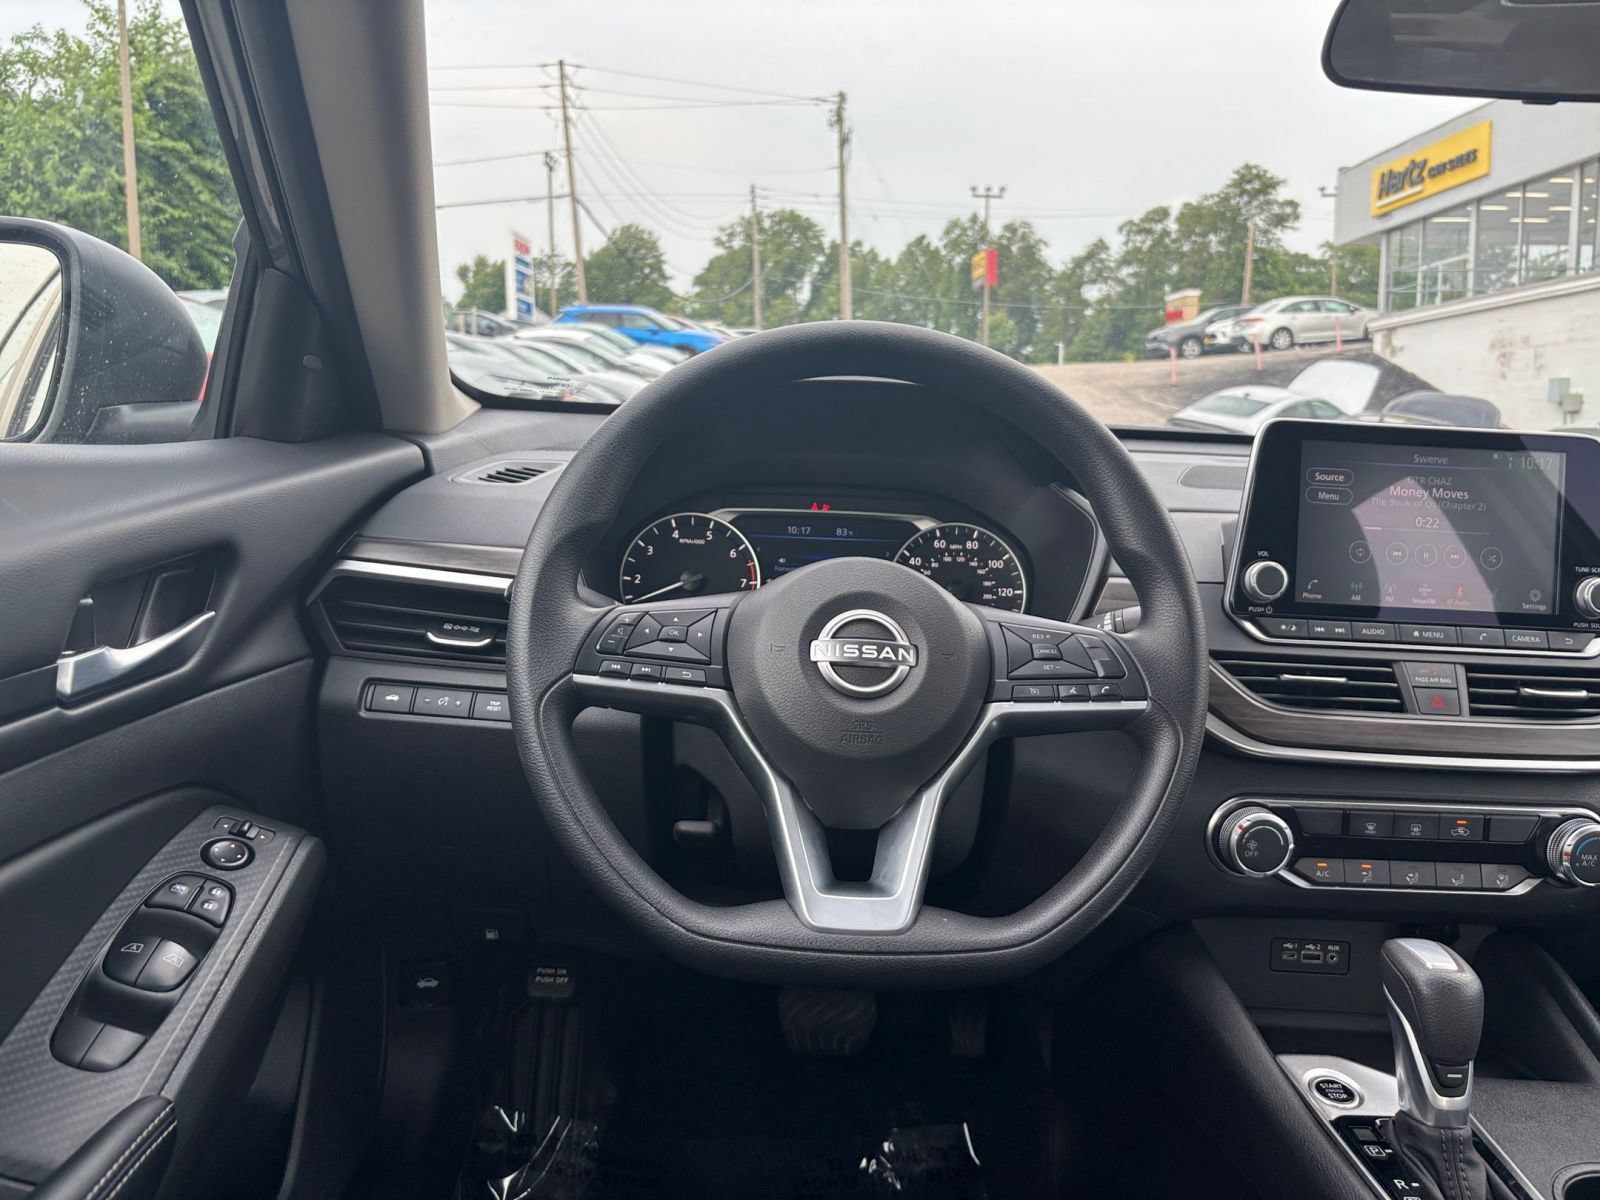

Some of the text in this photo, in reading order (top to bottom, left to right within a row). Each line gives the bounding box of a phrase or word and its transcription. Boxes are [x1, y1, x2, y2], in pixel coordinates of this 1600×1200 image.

[1377, 158, 1428, 201] Hertz
[1413, 454, 1449, 464] Swerve
[1520, 457, 1553, 470] 10:17
[1315, 471, 1345, 482] Source
[1428, 477, 1453, 486] CHAZ
[1318, 491, 1340, 501] Menu
[1389, 485, 1469, 500] Money Moves
[1415, 516, 1440, 529] 0:22
[672, 529, 679, 539] 4
[706, 530, 713, 541] 5
[787, 526, 812, 535] 10:17
[933, 539, 946, 549] 60
[966, 540, 979, 550] 80
[646, 545, 654, 555] 3
[729, 548, 737, 559] 6
[908, 556, 922, 566] 40
[988, 559, 1004, 569] 100
[634, 574, 641, 584] 2
[740, 578, 747, 588] 7
[997, 587, 1013, 597] 120
[1302, 591, 1322, 599] Phone
[1522, 602, 1547, 611] Settings
[668, 628, 680, 637] OK
[1361, 627, 1385, 636] AUDIO
[1422, 631, 1444, 639] MENU
[1512, 634, 1541, 643] CAMERA
[814, 644, 915, 662] NISSAN
[1036, 647, 1058, 655] CANCEL
[840, 734, 884, 745] AIRBAG
[1316, 870, 1330, 878] A/C
[555, 976, 569, 984] OFF
[1393, 1180, 1409, 1189] R
